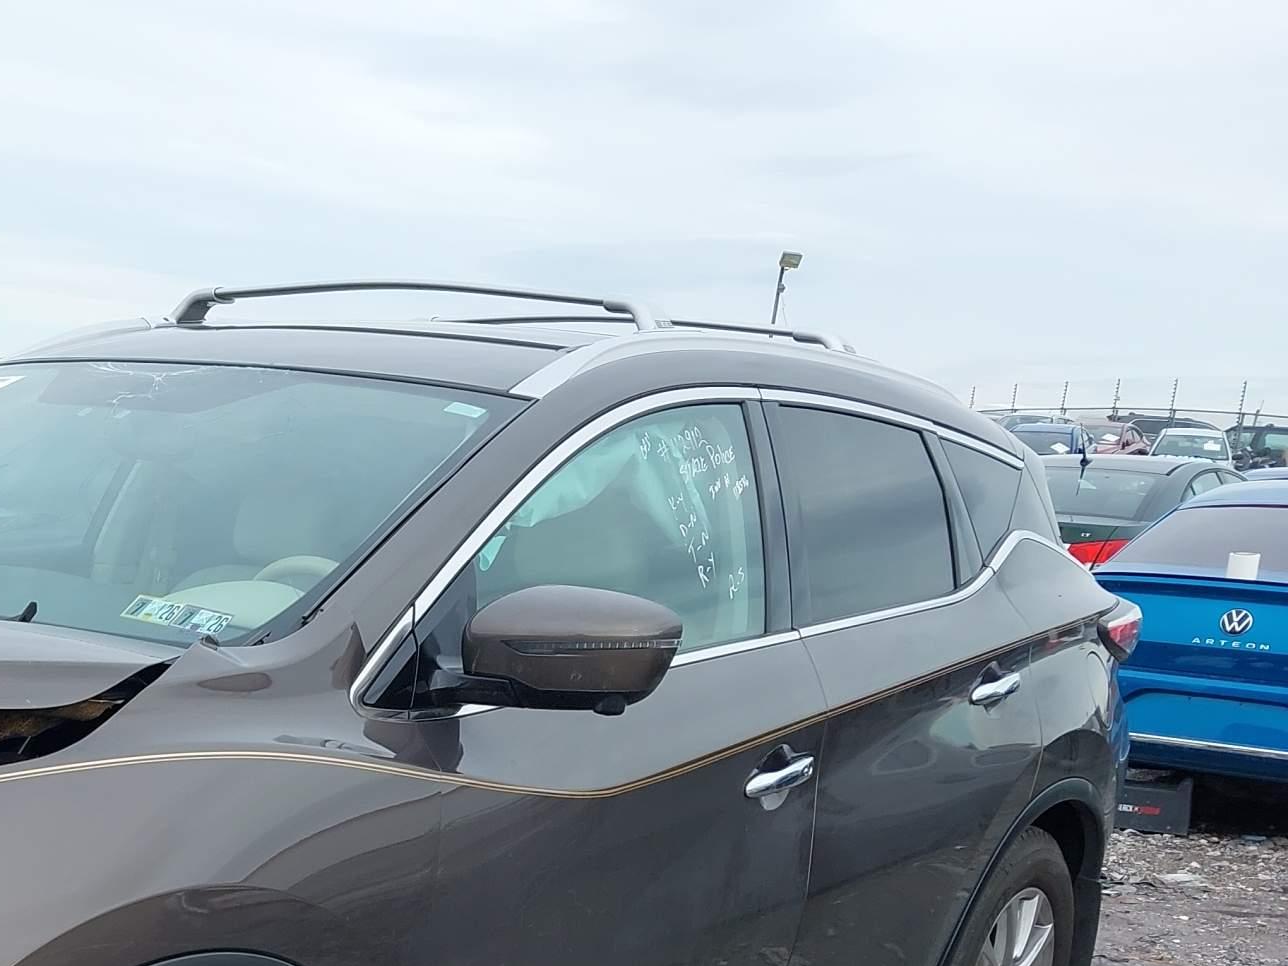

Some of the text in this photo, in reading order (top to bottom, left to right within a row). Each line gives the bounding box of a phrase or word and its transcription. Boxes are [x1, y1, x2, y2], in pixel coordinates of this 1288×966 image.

[158, 603, 181, 621] 26
[206, 615, 229, 633] 26
[1191, 637, 1271, 650] ARTEON
